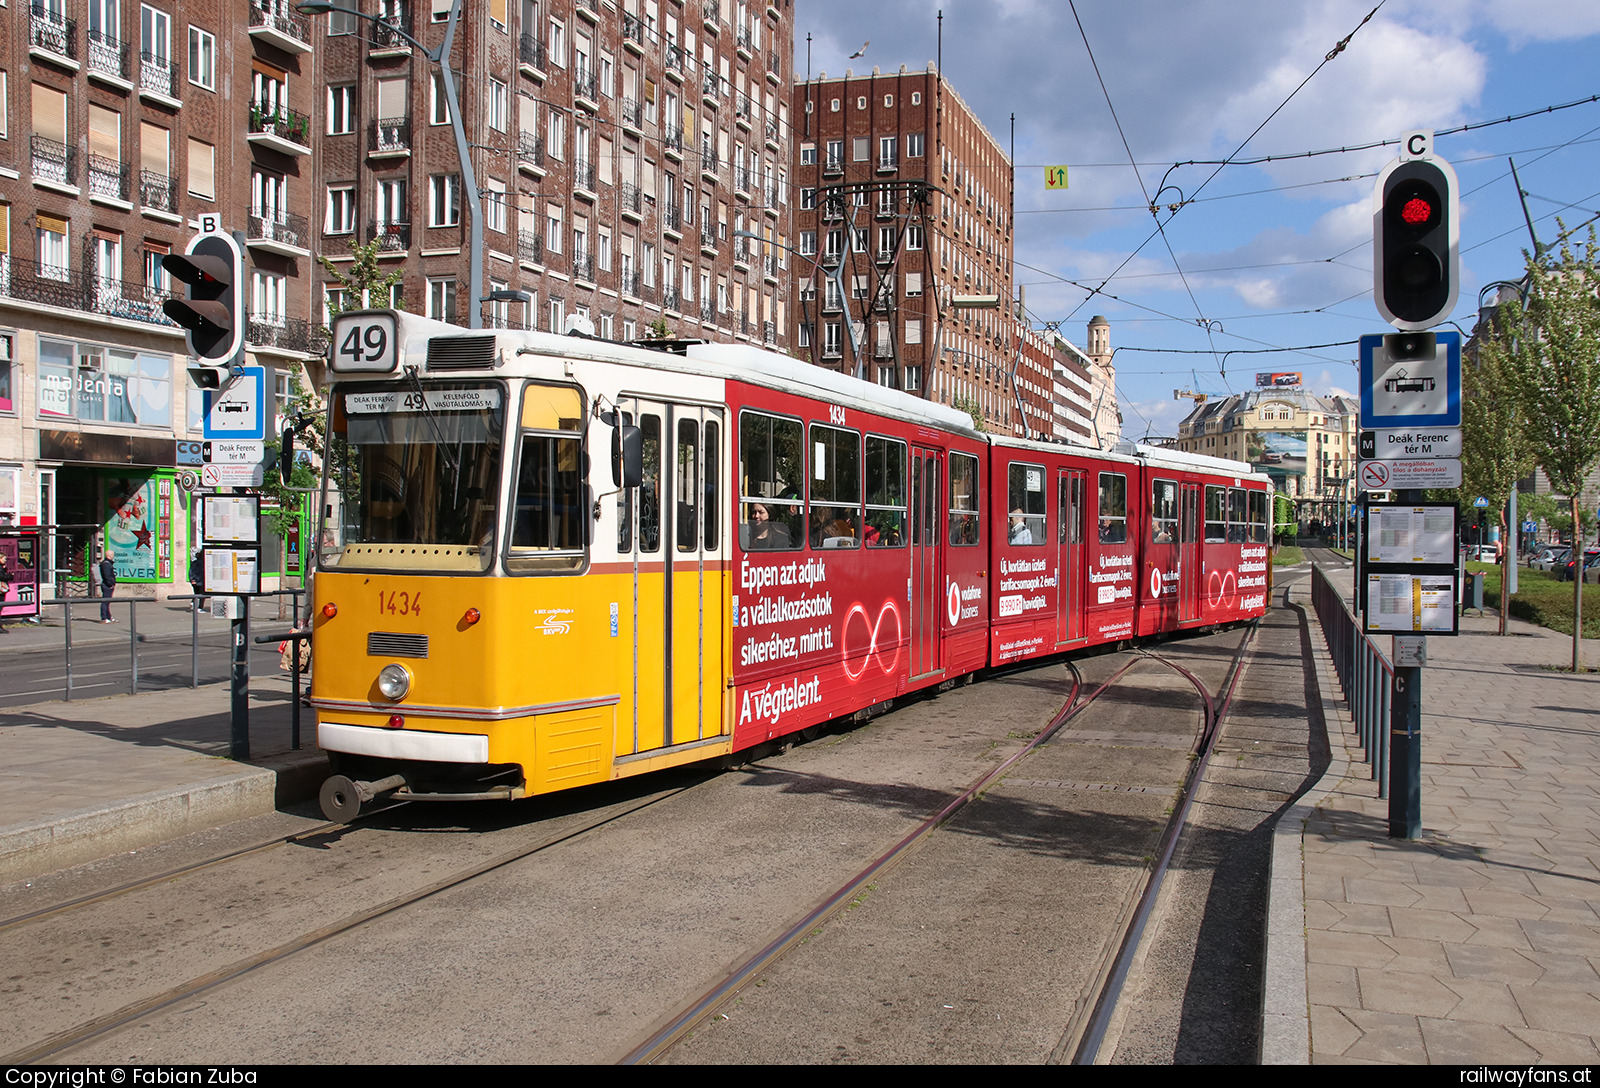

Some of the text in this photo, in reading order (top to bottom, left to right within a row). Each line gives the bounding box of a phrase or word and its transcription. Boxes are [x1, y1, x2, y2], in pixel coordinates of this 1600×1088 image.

[1407, 134, 1427, 156] C
[203, 216, 216, 233] B
[340, 324, 387, 362] 49
[372, 395, 395, 403] FERENC
[403, 392, 424, 410] 49
[828, 404, 846, 426] 1434
[1362, 440, 1373, 449] M
[1388, 433, 1449, 443] Deák Ferenc
[203, 448, 211, 456] M
[219, 443, 256, 452] Deák Ferenc
[1404, 444, 1432, 454] tér M
[741, 553, 826, 595] Éppen azt adjuk
[1008, 559, 1031, 573] korlátlan
[1032, 558, 1046, 572] üzleti
[1000, 576, 1040, 592] tarifacsomagok
[1040, 575, 1044, 588] 2
[961, 585, 982, 601] vodafone
[379, 590, 421, 616] 1434
[740, 605, 749, 627] a
[750, 590, 833, 626] vállalkozásotok
[1001, 600, 1004, 612] 9
[1005, 599, 1015, 612] 990
[961, 604, 979, 620] business
[236, 632, 245, 646] B
[740, 624, 834, 667] sikeréhez, mint ti.
[1396, 676, 1404, 693] C
[739, 675, 823, 726] A végtelent.
